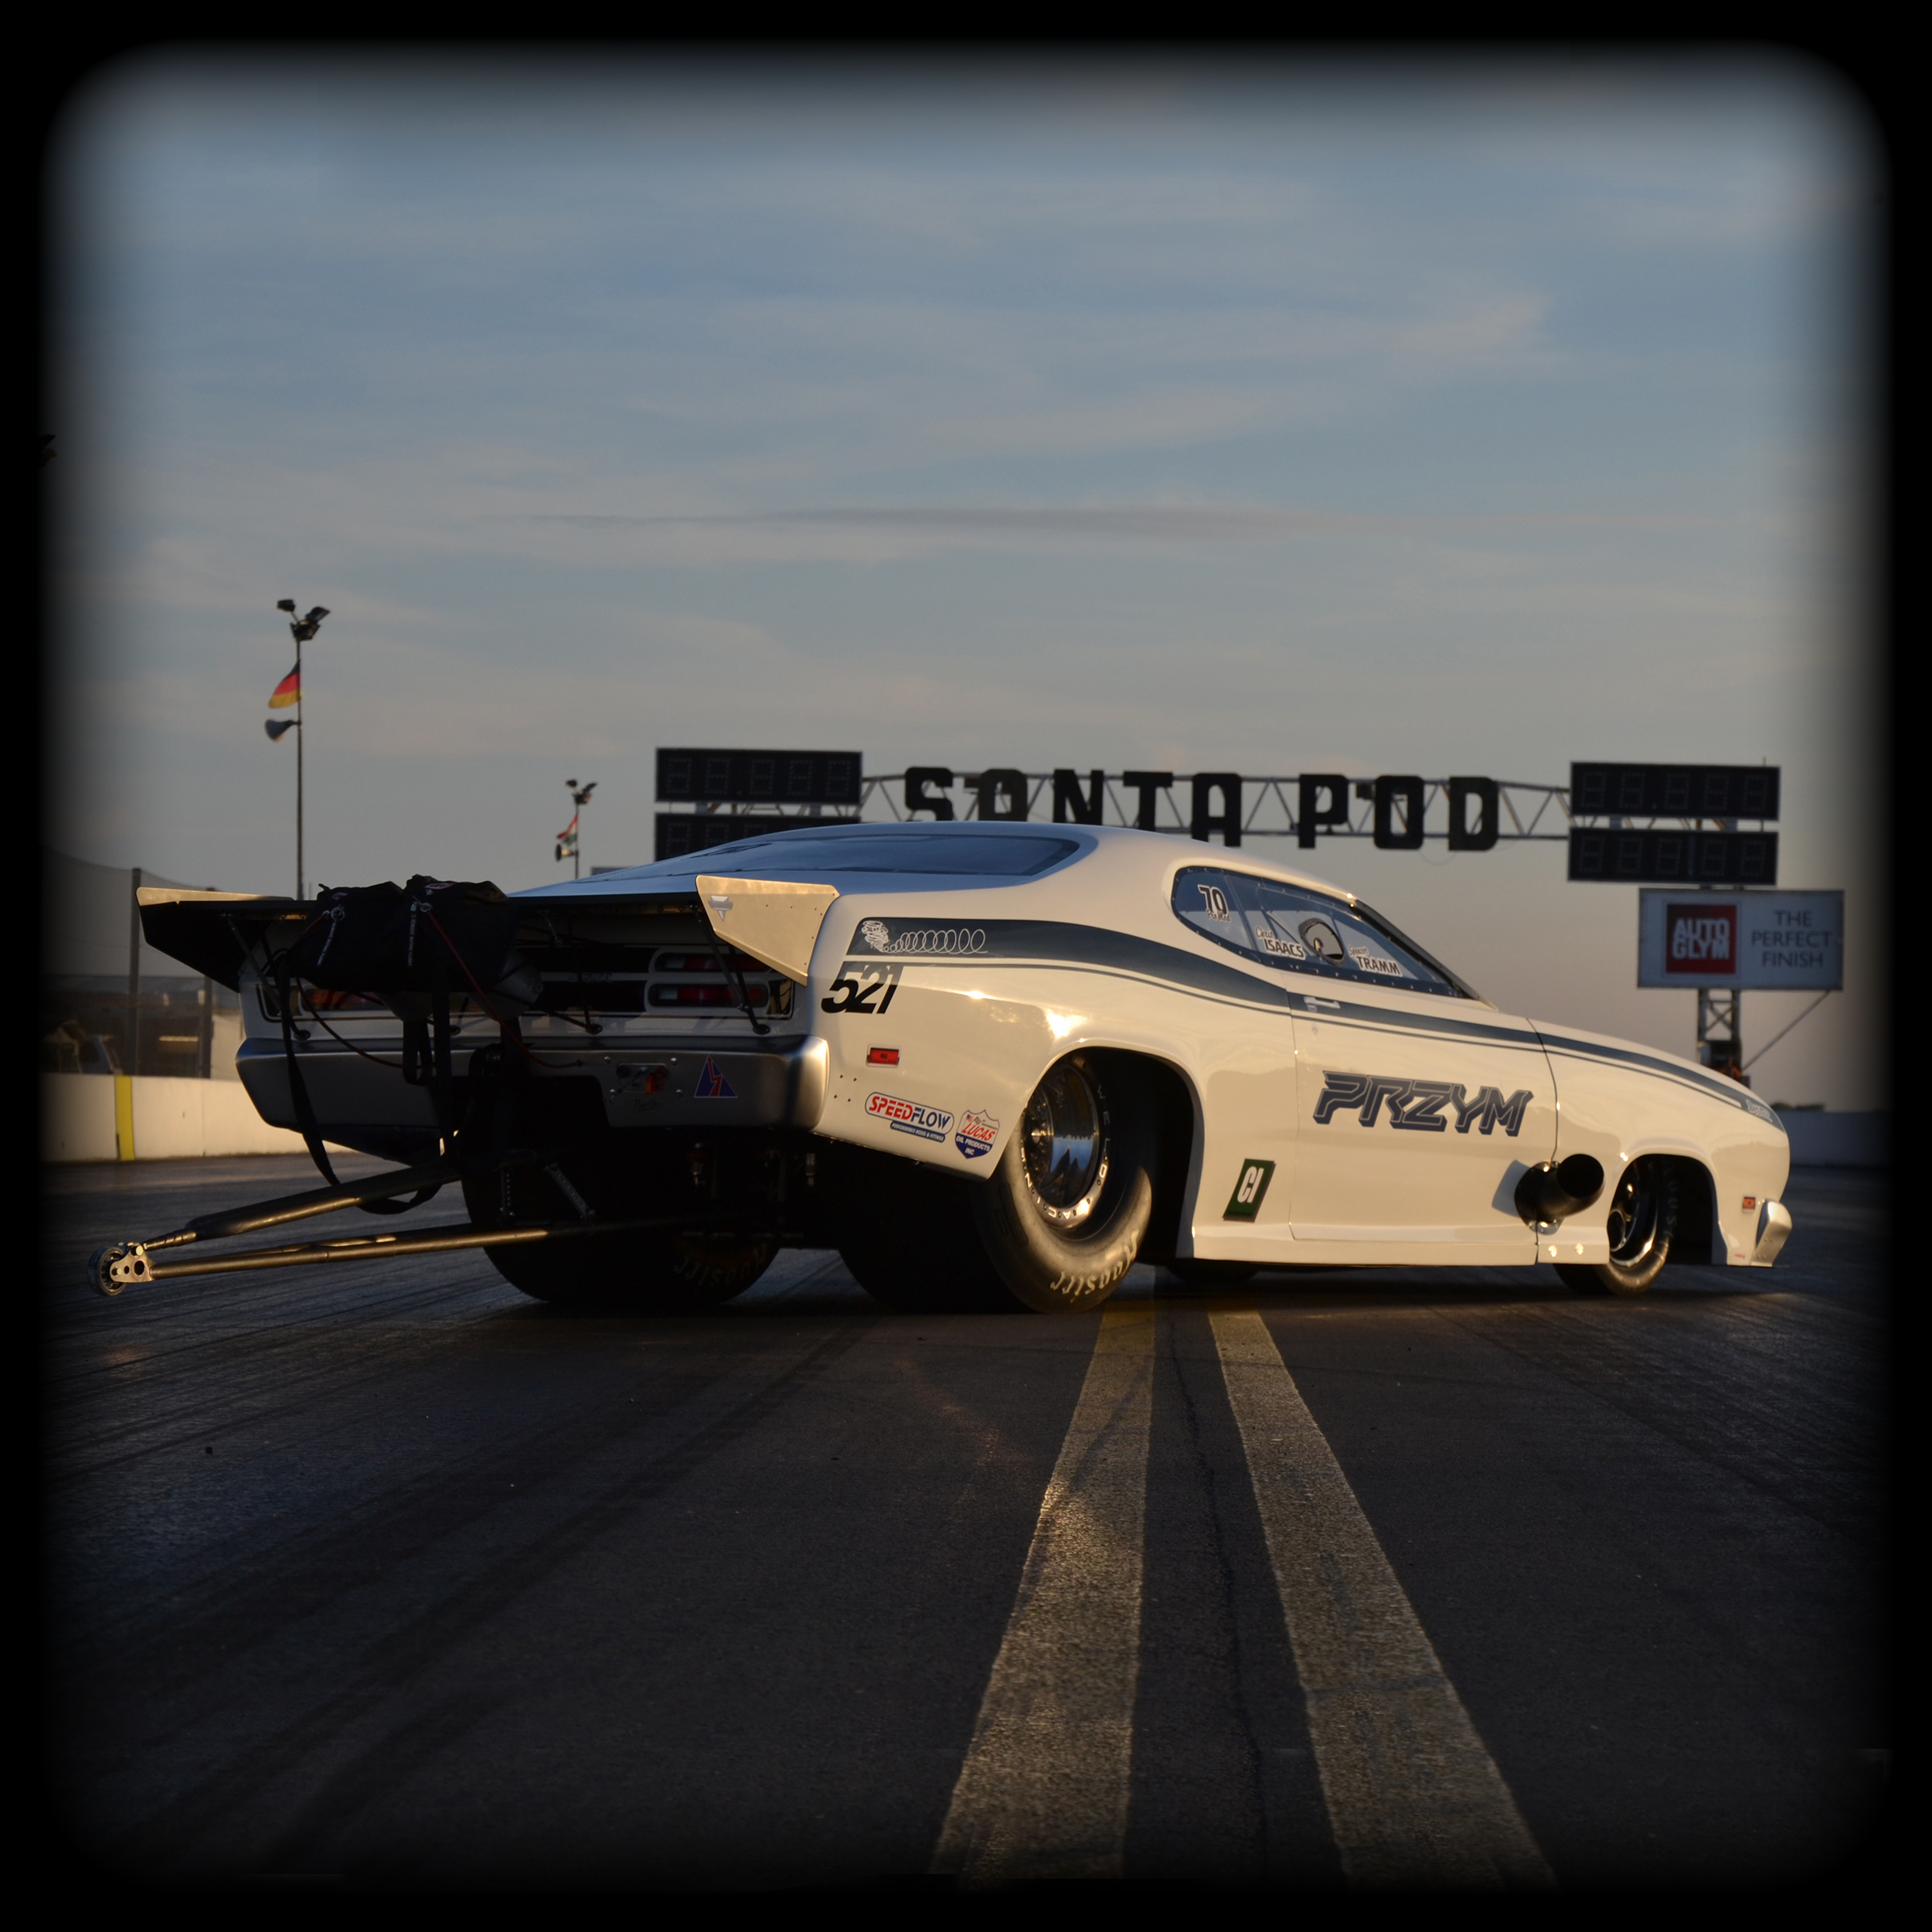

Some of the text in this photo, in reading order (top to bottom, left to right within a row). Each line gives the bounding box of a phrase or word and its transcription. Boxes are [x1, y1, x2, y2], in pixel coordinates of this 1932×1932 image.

[906, 767, 1499, 852] SANTA POD
[1198, 885, 1228, 915] 70
[1672, 917, 1730, 940] AUTO
[1774, 910, 1812, 928] THE
[1256, 927, 1274, 938] Chris
[1752, 930, 1833, 948] PERFECT
[1264, 938, 1304, 958] ISAACS
[1672, 935, 1730, 961] GLYM
[1356, 956, 1401, 975] TRAMM
[1763, 951, 1824, 968] FINISH
[821, 962, 903, 1015] 521
[869, 1096, 951, 1130] SPEEDFLOW
[1313, 1070, 1533, 1137] PRZYM
[961, 1123, 995, 1141] LUCAS
[956, 1135, 991, 1151] OIL PRODUCTS
